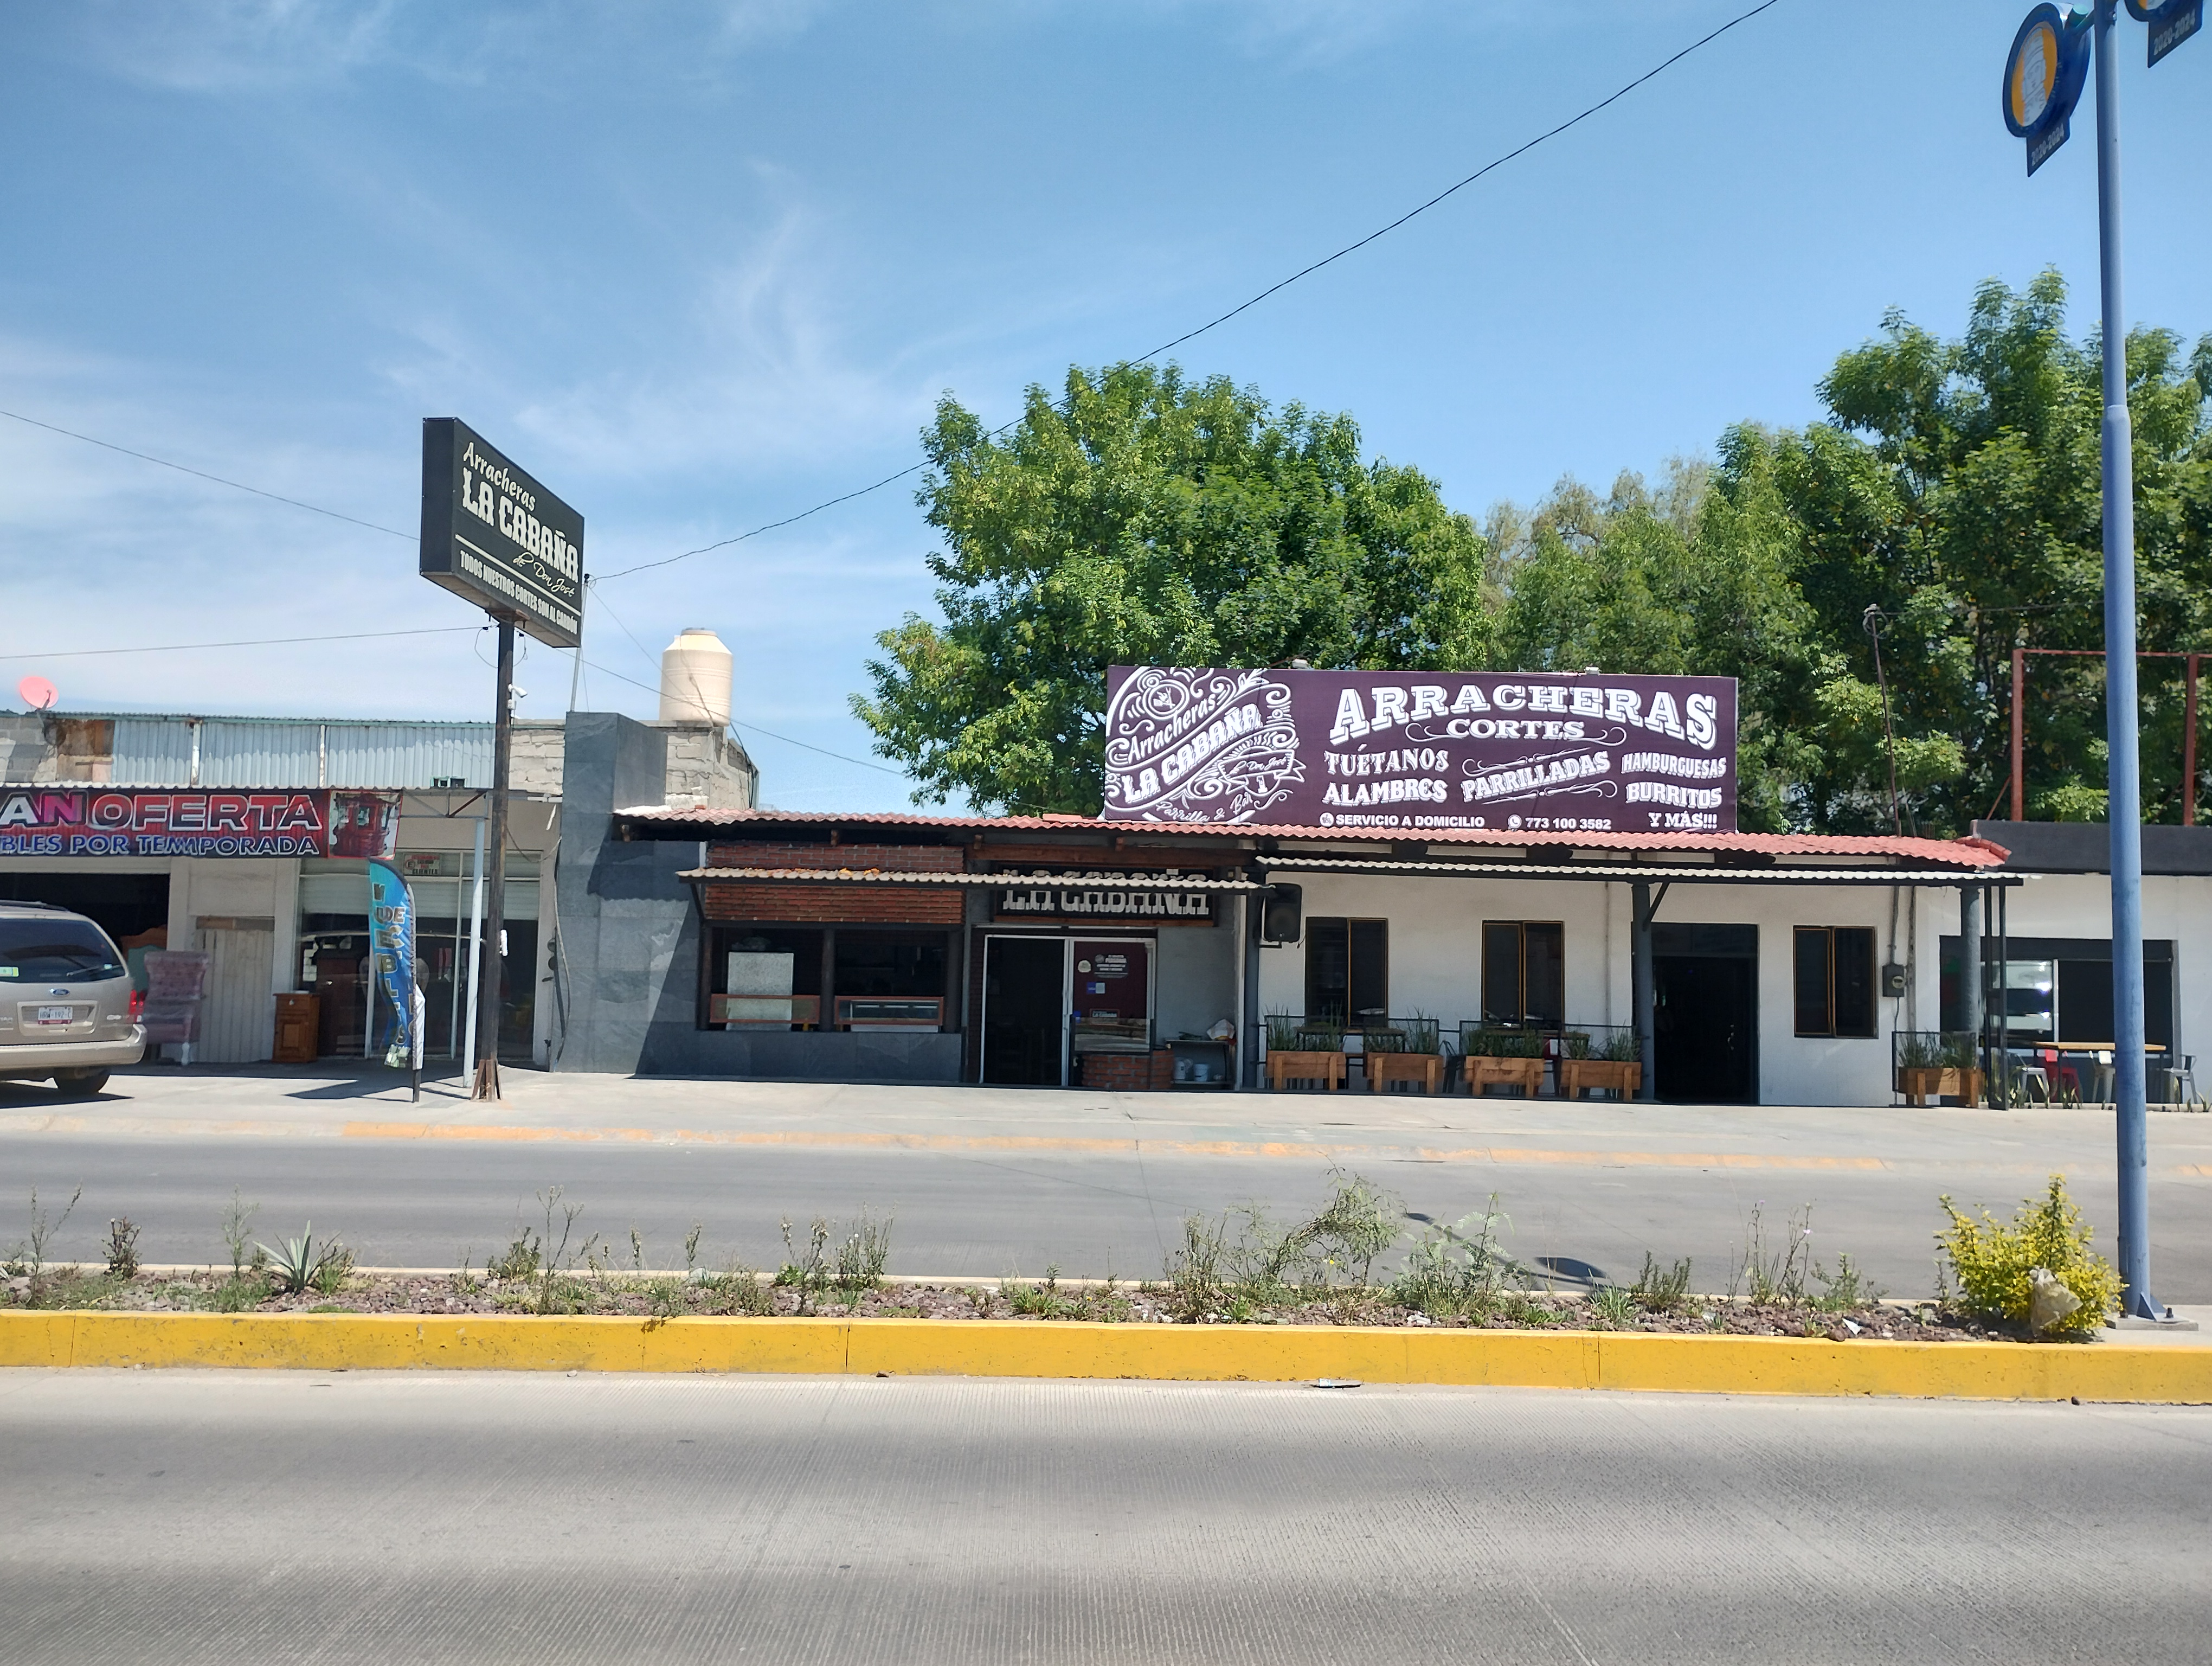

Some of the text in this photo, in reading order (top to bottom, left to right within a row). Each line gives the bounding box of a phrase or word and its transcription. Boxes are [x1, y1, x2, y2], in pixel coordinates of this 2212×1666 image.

[463, 442, 536, 511] Arracheras
[462, 467, 578, 582] LA CABAÑA
[460, 550, 483, 578] TODOS
[483, 564, 515, 597] NUESTROS
[516, 584, 537, 611] CORTES
[538, 598, 549, 618] SON
[549, 605, 556, 623] AL
[533, 562, 552, 586] Don
[1128, 694, 1216, 764] Arracheras
[1329, 684, 1718, 751] ARRACHERAS
[1446, 719, 1585, 740] CORTES
[1121, 704, 1264, 803] LA CABAÑA
[1323, 744, 1449, 777] TUÉTANOS
[1621, 752, 1727, 779] HAMBURGUESAS
[1461, 751, 1611, 803] PARRILLADAS
[1156, 792, 1253, 822] Parrilla & Bar
[1322, 778, 1448, 807] ALAMBRES
[1625, 781, 1722, 809] BURRITOS
[0, 792, 322, 831] AN OFERTA
[1336, 814, 1485, 828] SERVICIO A DOMICILIO
[1525, 817, 1611, 830] 773 100 3582
[1648, 810, 1718, 829] Y MÁS!!!
[0, 834, 319, 856] BLES POR TEMPORADA
